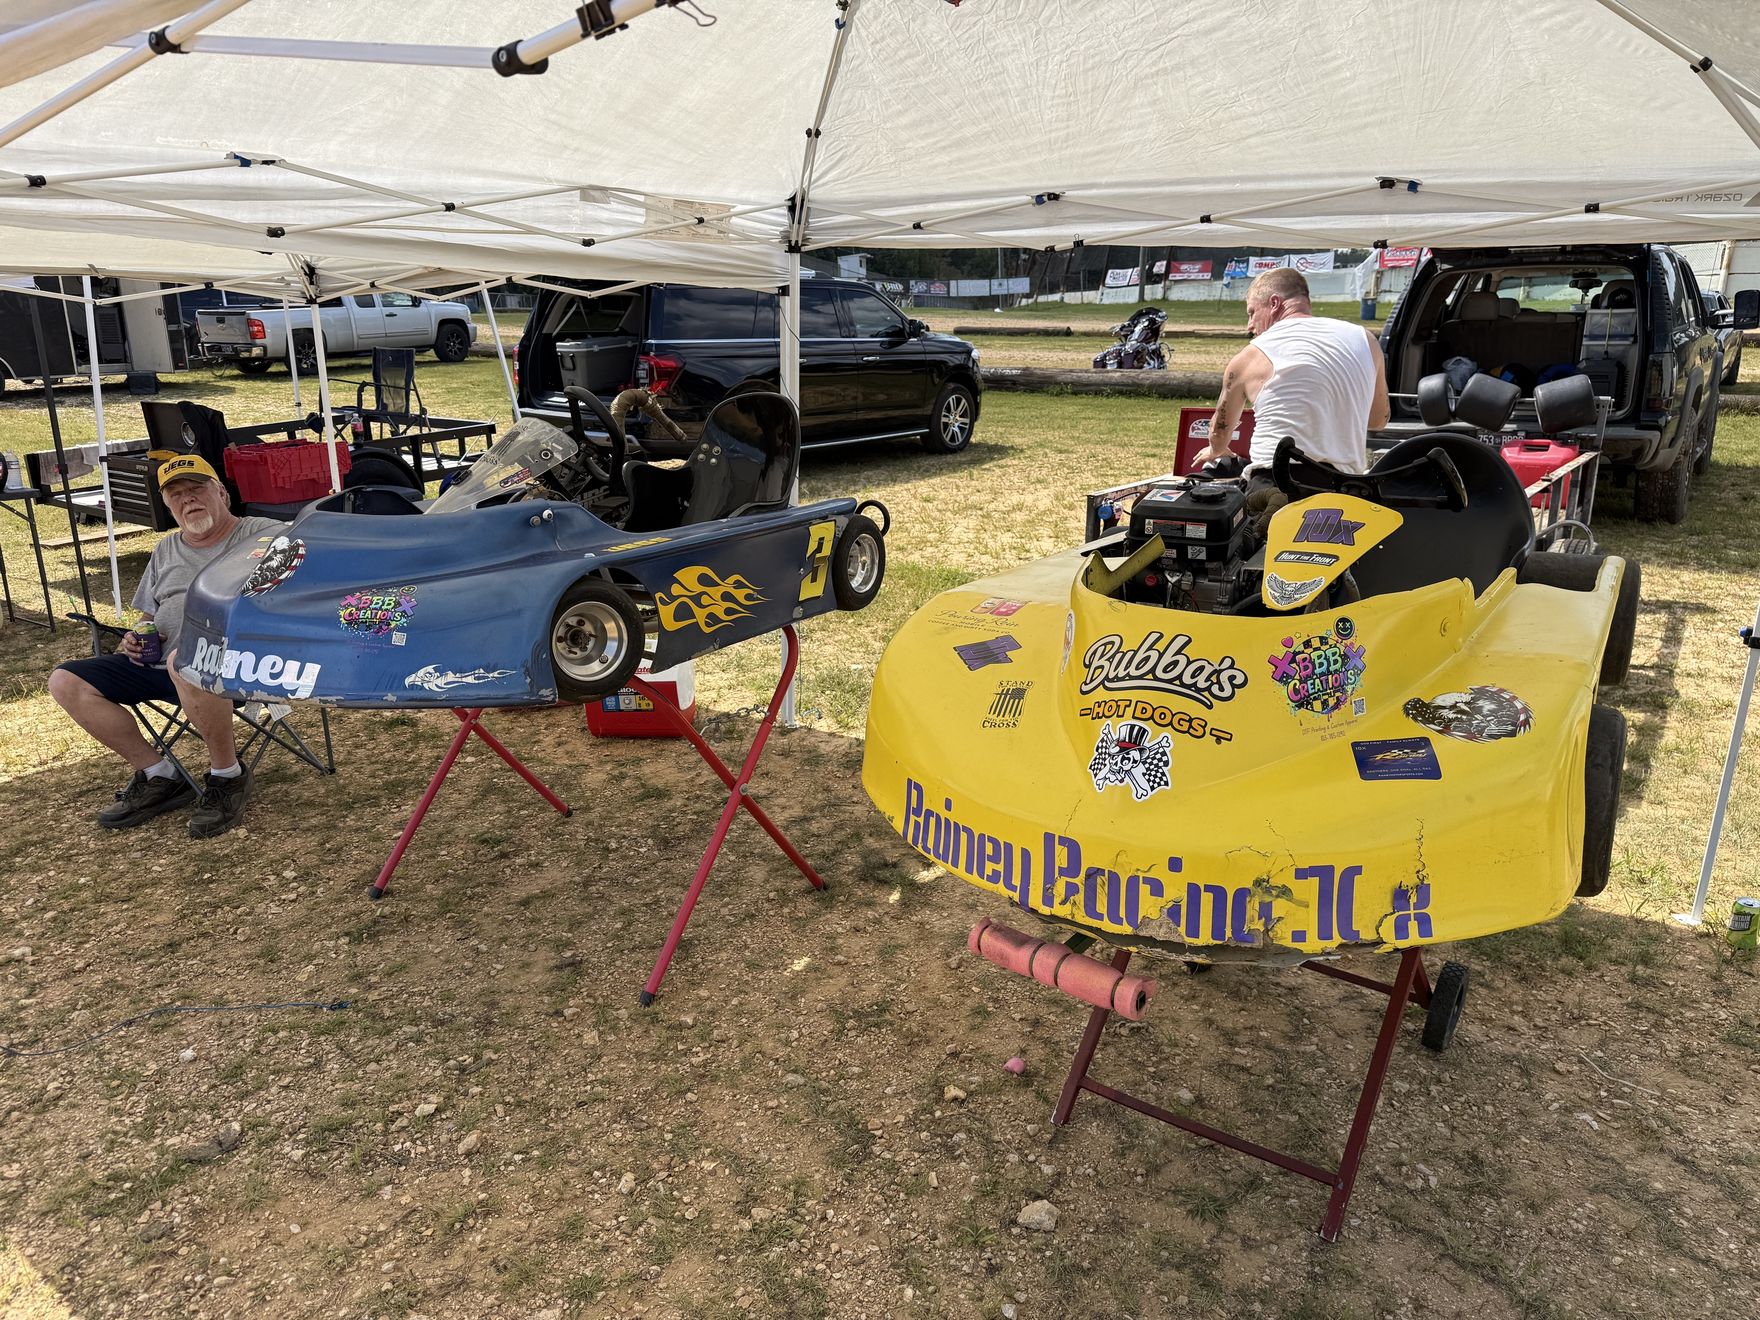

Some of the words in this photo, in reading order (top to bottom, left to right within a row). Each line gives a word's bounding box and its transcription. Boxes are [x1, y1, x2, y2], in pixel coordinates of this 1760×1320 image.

[1477, 434, 1495, 446] 753
[163, 459, 195, 474] JEGS
[799, 519, 837, 602] 3
[359, 596, 396, 609] BBB
[191, 636, 321, 700] Rainey
[1079, 631, 1249, 702] Bubba's
[1295, 646, 1343, 677] BBB
[999, 680, 1034, 688] STAND
[982, 719, 1019, 729] CROSS
[1091, 699, 1132, 720] HOT
[1132, 700, 1208, 738] DOGS
[902, 777, 1033, 914] Rainey
